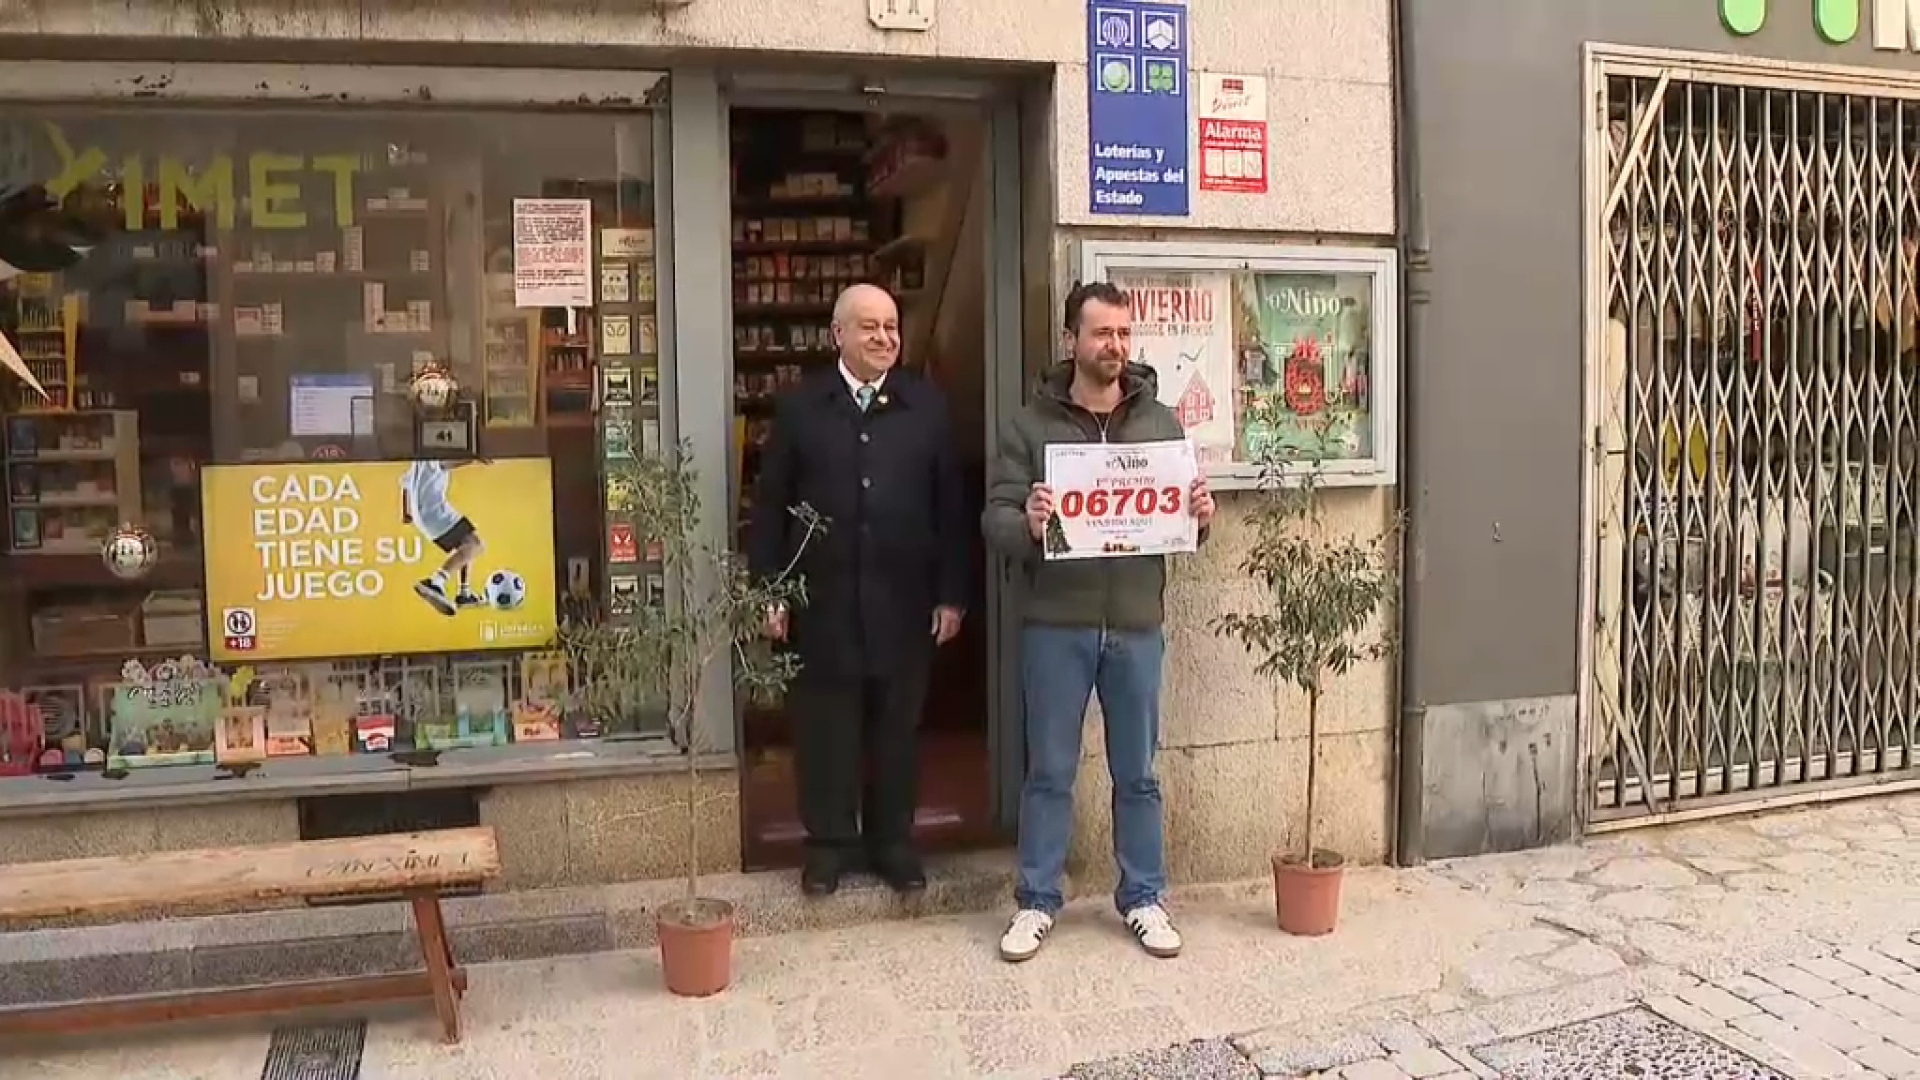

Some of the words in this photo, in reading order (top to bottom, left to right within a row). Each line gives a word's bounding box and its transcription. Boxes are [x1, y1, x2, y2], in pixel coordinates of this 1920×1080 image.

[1205, 122, 1261, 139] Alarma
[1095, 142, 1151, 159] Loterías
[1155, 147, 1165, 164] y
[1095, 167, 1159, 184] Apuestas
[1164, 168, 1184, 183] del
[1095, 189, 1143, 205] Estado
[252, 473, 361, 504] CADA
[1061, 486, 1182, 519] 06703
[254, 507, 359, 536] EDAD
[255, 538, 363, 569] TIENE
[375, 535, 421, 565] SU
[256, 569, 384, 601] JUEGO
[229, 636, 252, 649] +18
